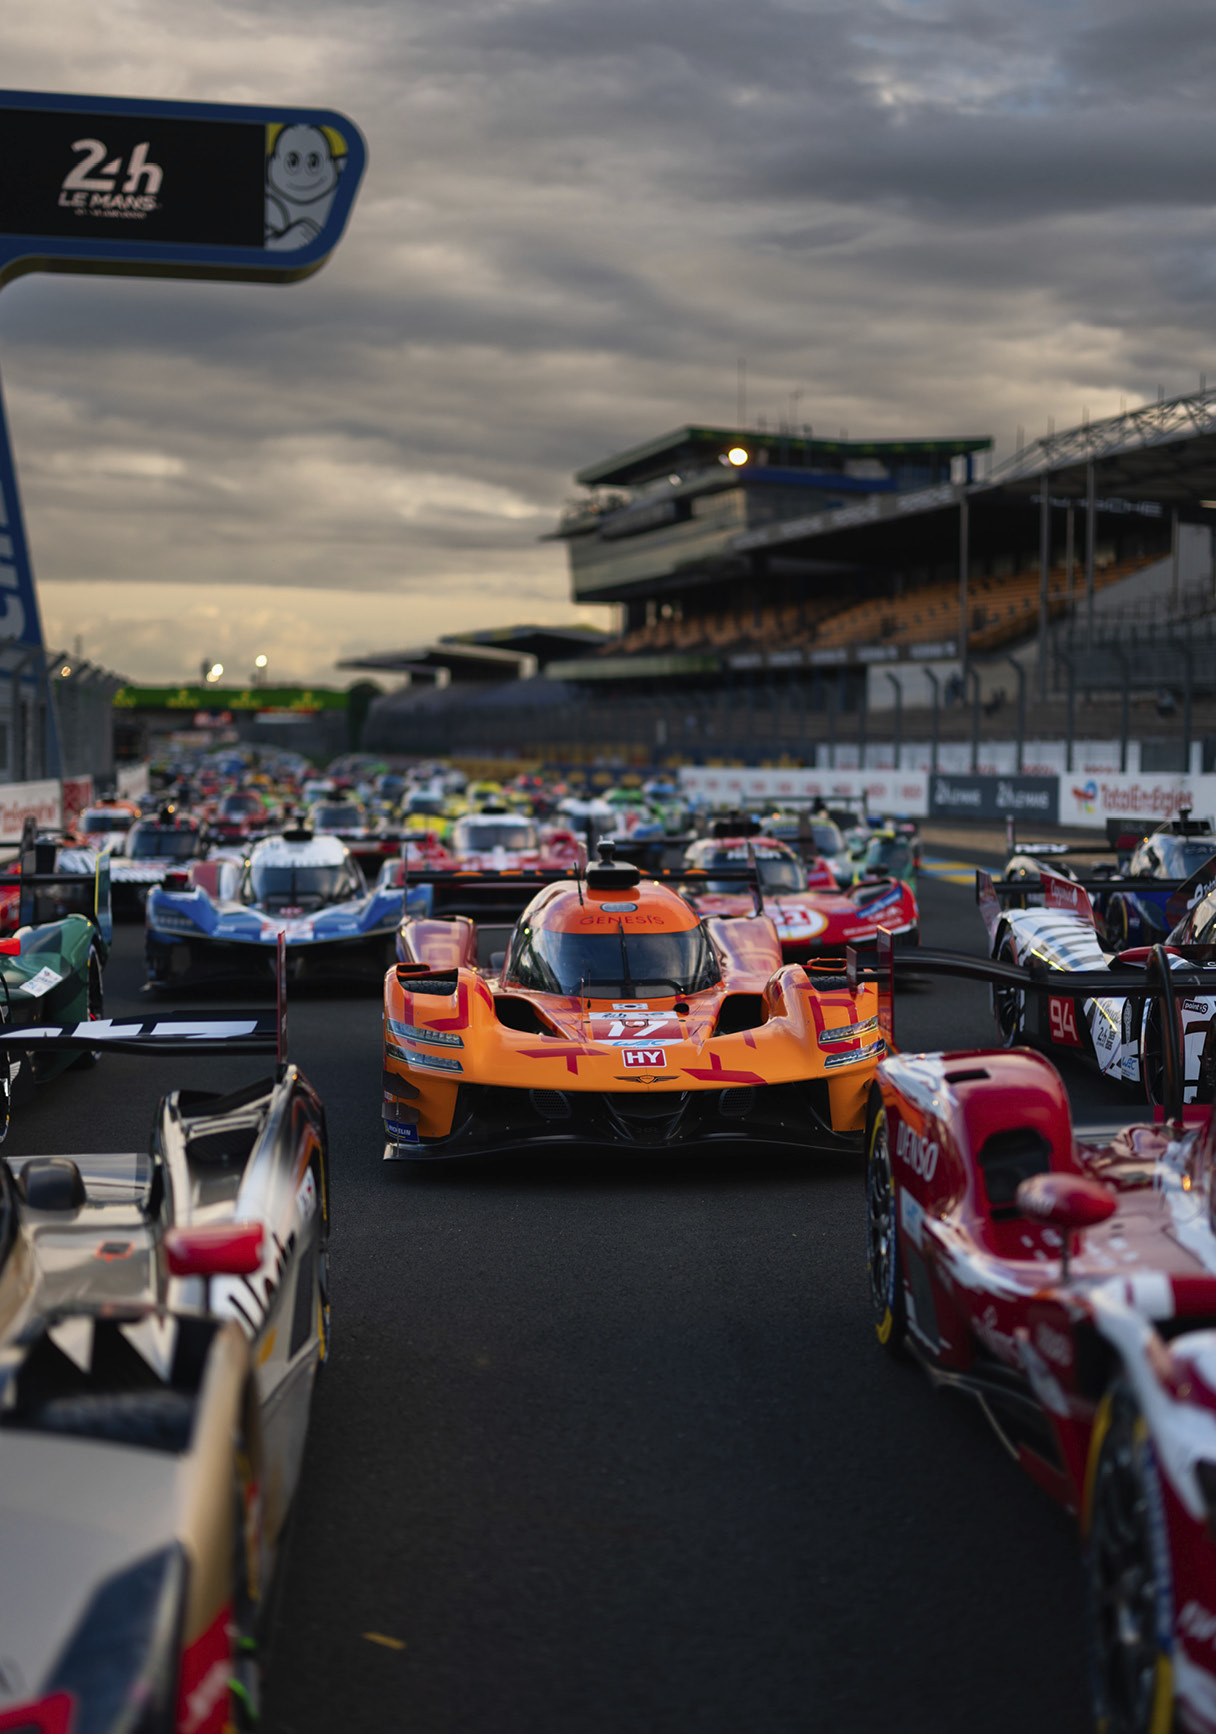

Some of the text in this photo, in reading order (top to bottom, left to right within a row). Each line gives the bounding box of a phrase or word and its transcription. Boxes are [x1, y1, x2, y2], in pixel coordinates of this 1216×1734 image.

[62, 138, 163, 194] 24h
[58, 191, 157, 211] LE MANS
[580, 916, 664, 925] GENESIS
[608, 1021, 669, 1037] 17
[1051, 1000, 1077, 1041] 94
[627, 1051, 661, 1064] HY
